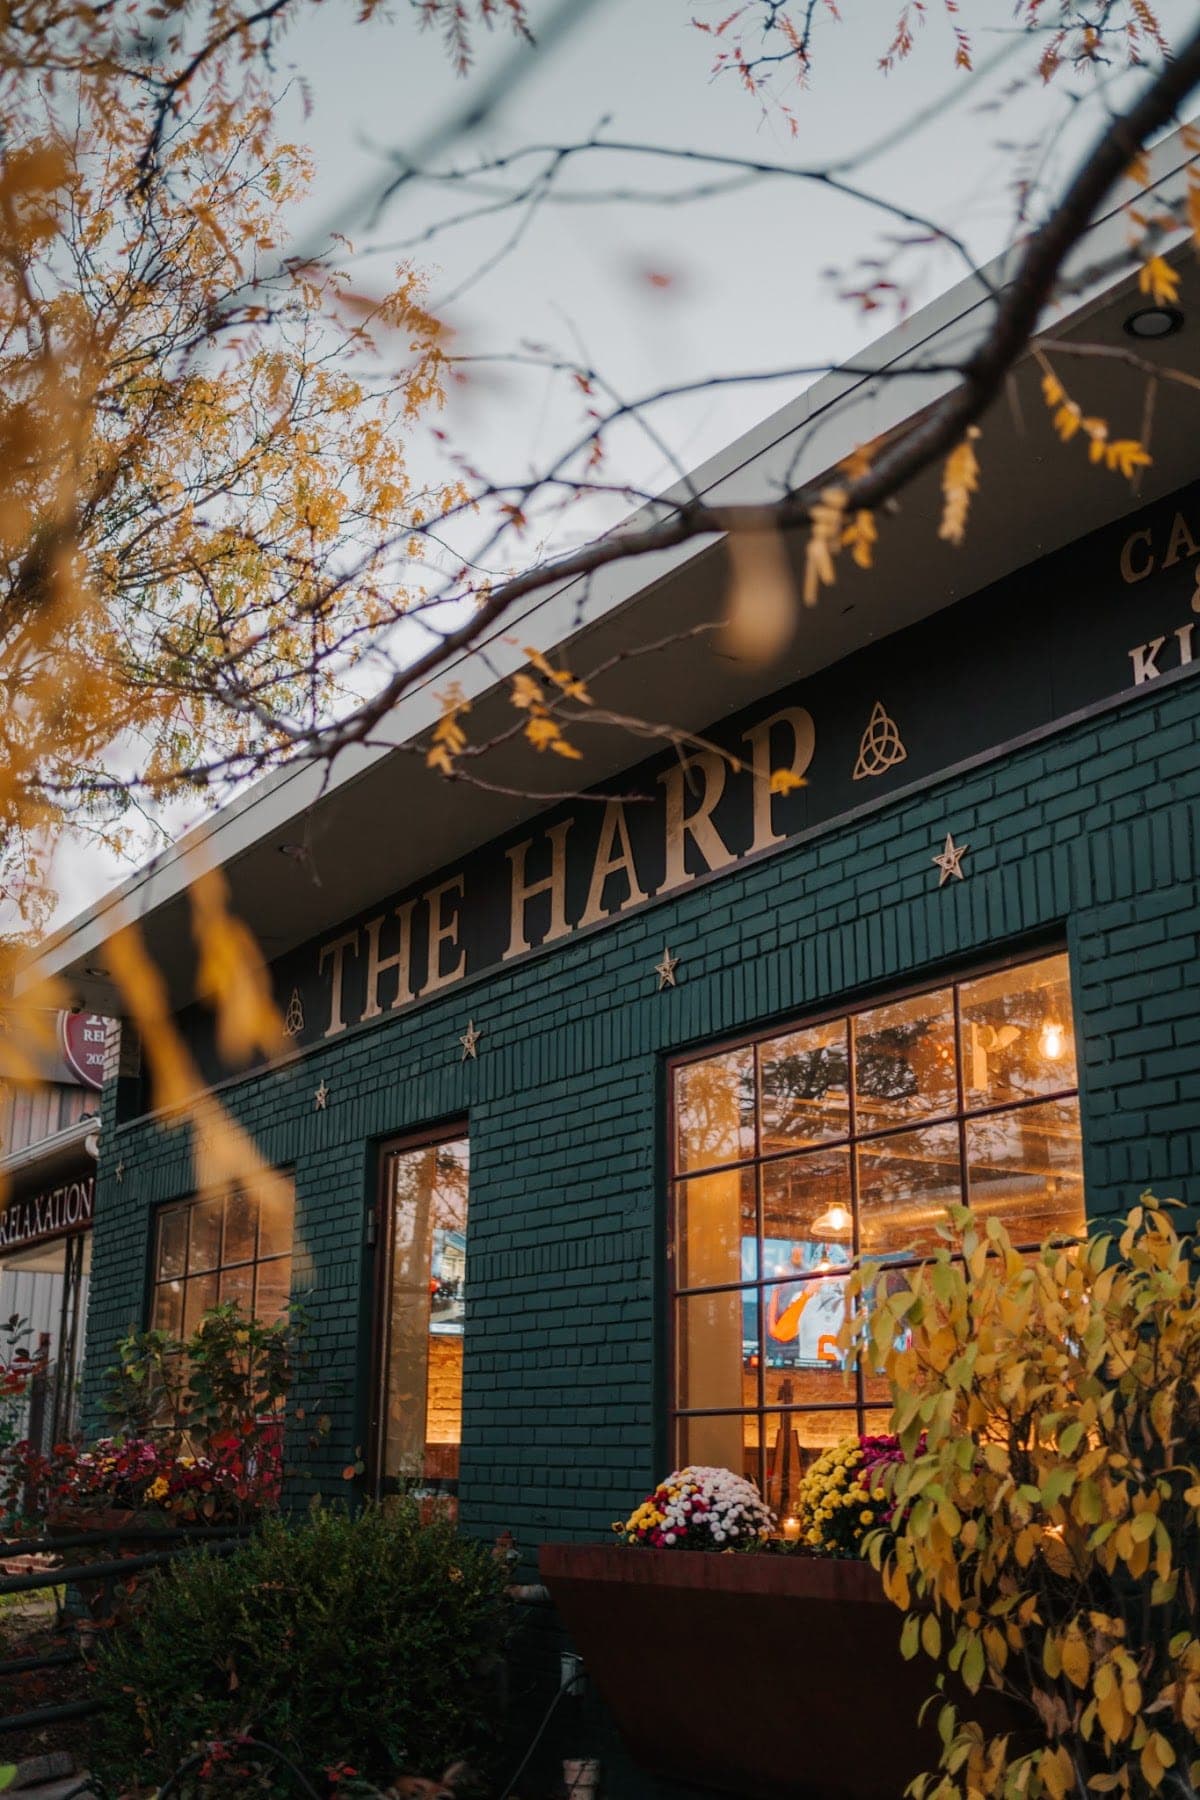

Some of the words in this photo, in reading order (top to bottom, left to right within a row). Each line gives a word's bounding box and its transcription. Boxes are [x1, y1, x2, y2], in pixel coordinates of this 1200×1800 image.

[1128, 623, 1194, 686] KI
[318, 873, 466, 1038] THE
[502, 706, 816, 961] HARP
[0, 1177, 94, 1246] RELAXATION
